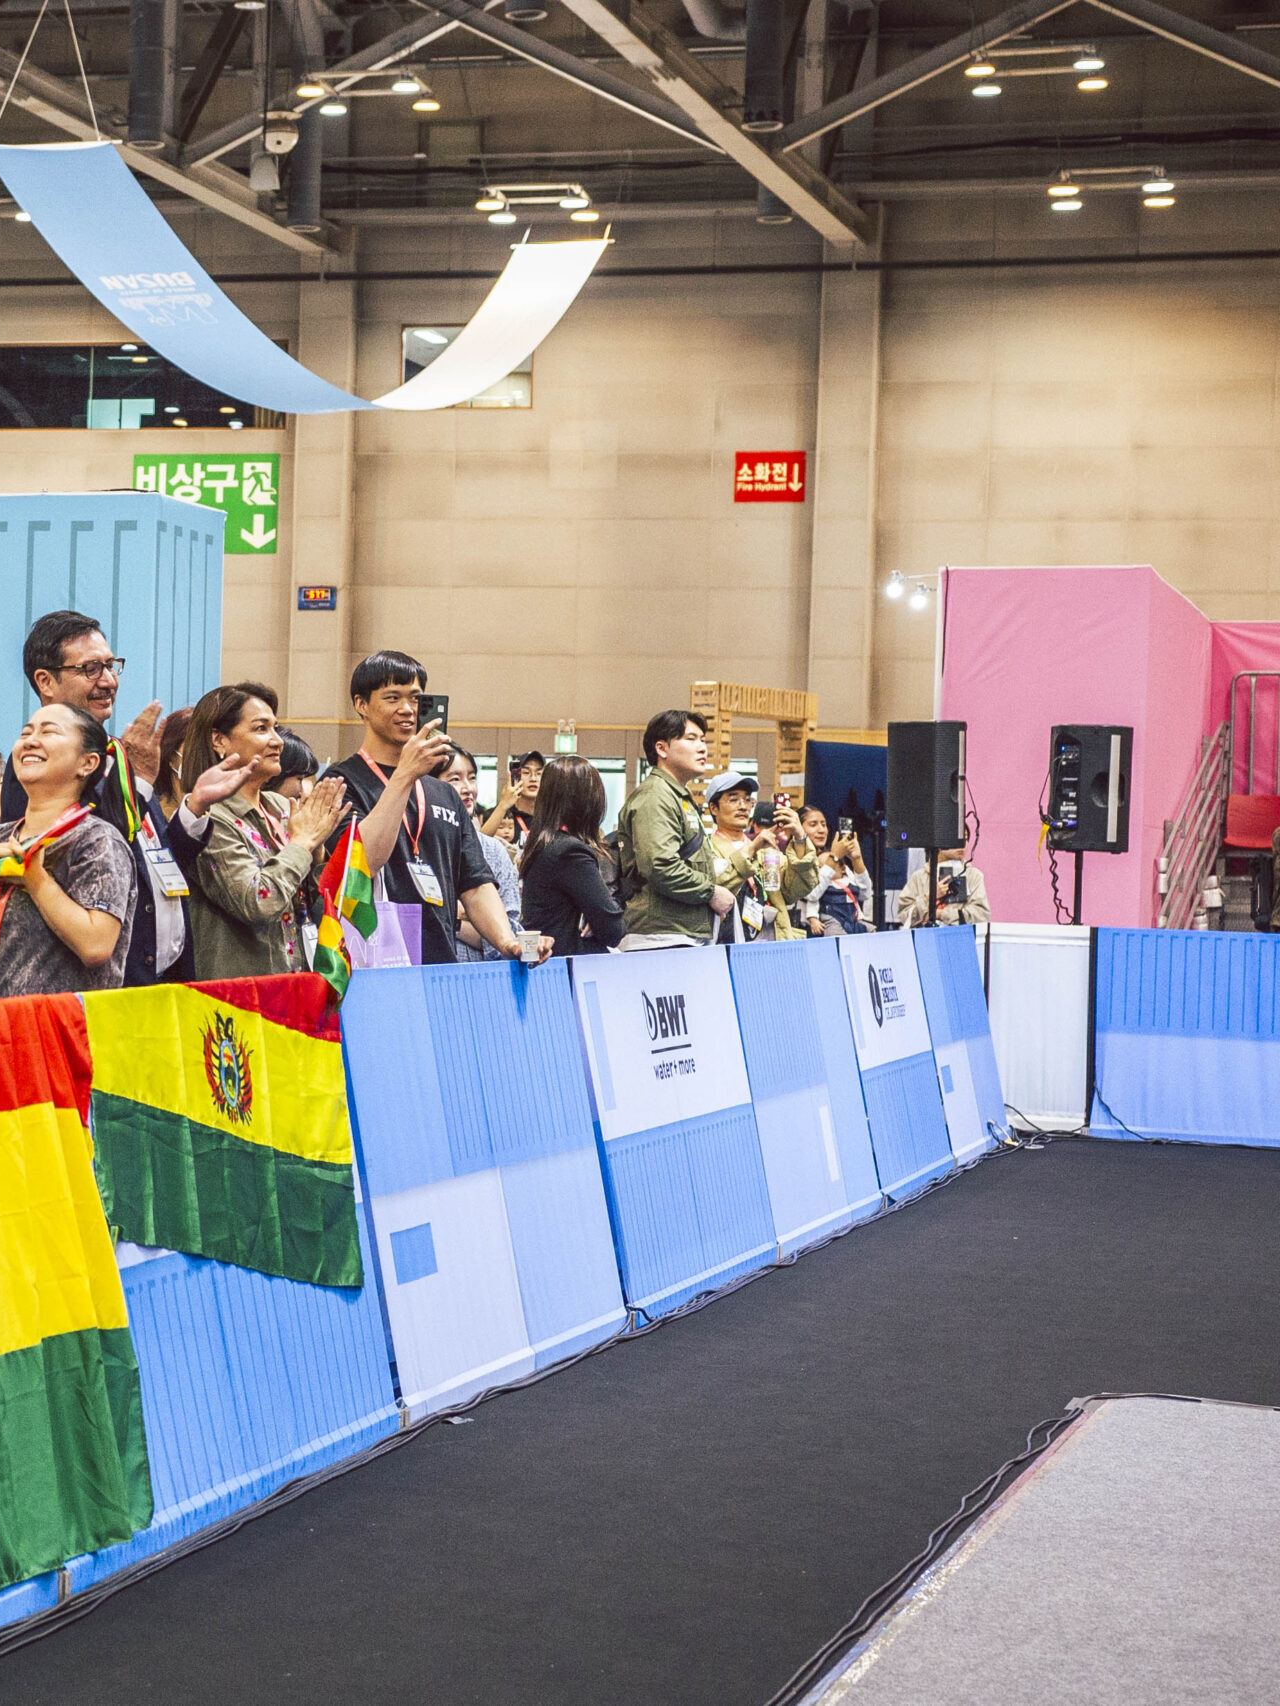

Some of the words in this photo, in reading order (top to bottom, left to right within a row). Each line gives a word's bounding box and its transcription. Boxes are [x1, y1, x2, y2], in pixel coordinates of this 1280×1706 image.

[99, 271, 196, 290] BUSAN
[135, 462, 239, 504] 비상구
[737, 462, 787, 482] 소화전
[431, 804, 460, 827] FIX.
[655, 994, 688, 1039] BWT
